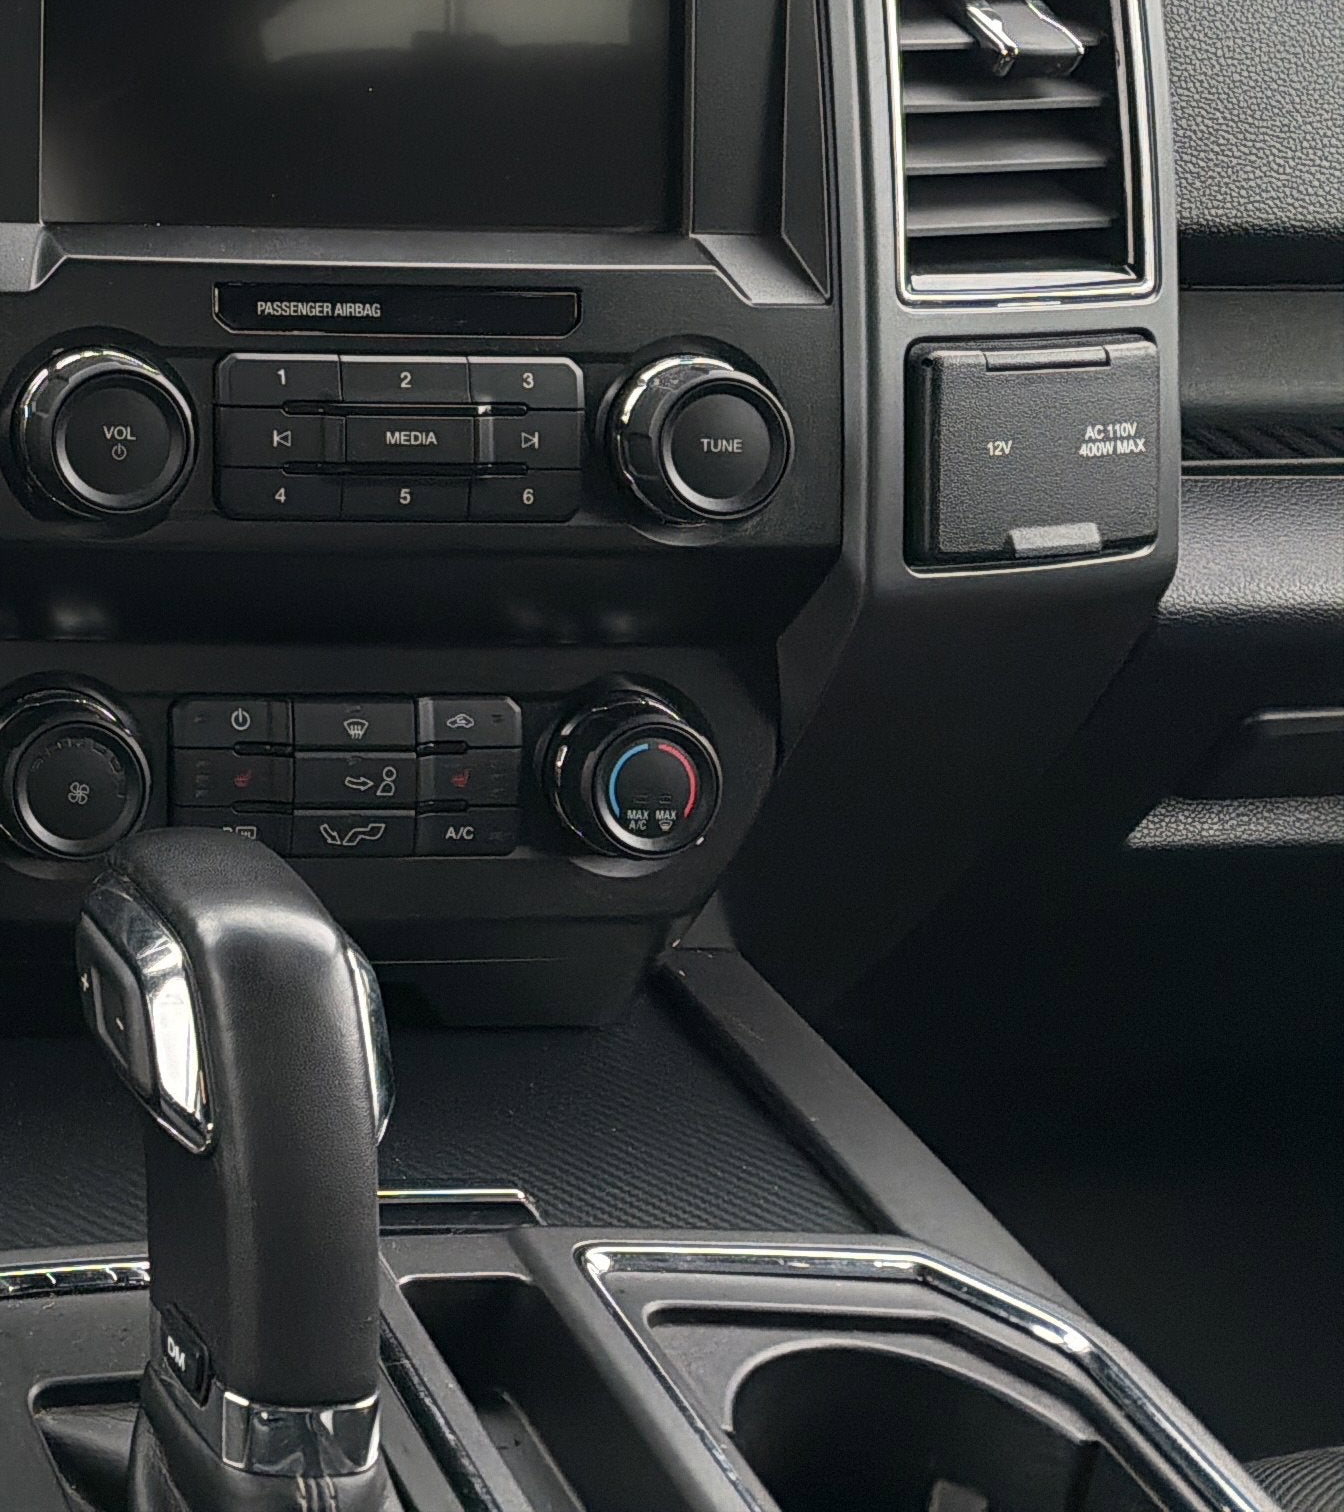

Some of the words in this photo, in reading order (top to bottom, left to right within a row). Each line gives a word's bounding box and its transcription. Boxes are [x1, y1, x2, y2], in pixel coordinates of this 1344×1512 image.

[256, 300, 333, 317] PASSENGER
[333, 302, 382, 318] AIRBAG
[277, 369, 288, 385] 1
[399, 371, 413, 388] 2
[521, 372, 535, 389] 3
[102, 425, 137, 441] VOL
[385, 430, 438, 447] MEDIA
[1084, 424, 1104, 440] AC
[1106, 421, 1138, 439] 110V
[700, 437, 744, 454] TUNE
[986, 440, 1013, 456] 12V
[1078, 440, 1114, 458] 400W
[1115, 438, 1147, 455] MAX
[274, 488, 287, 504] 4
[399, 488, 412, 505] 5
[522, 489, 535, 505] 6
[626, 809, 650, 820] MAX
[655, 809, 678, 820] MAX
[444, 826, 475, 840] A/C
[627, 819, 648, 831] A/C
